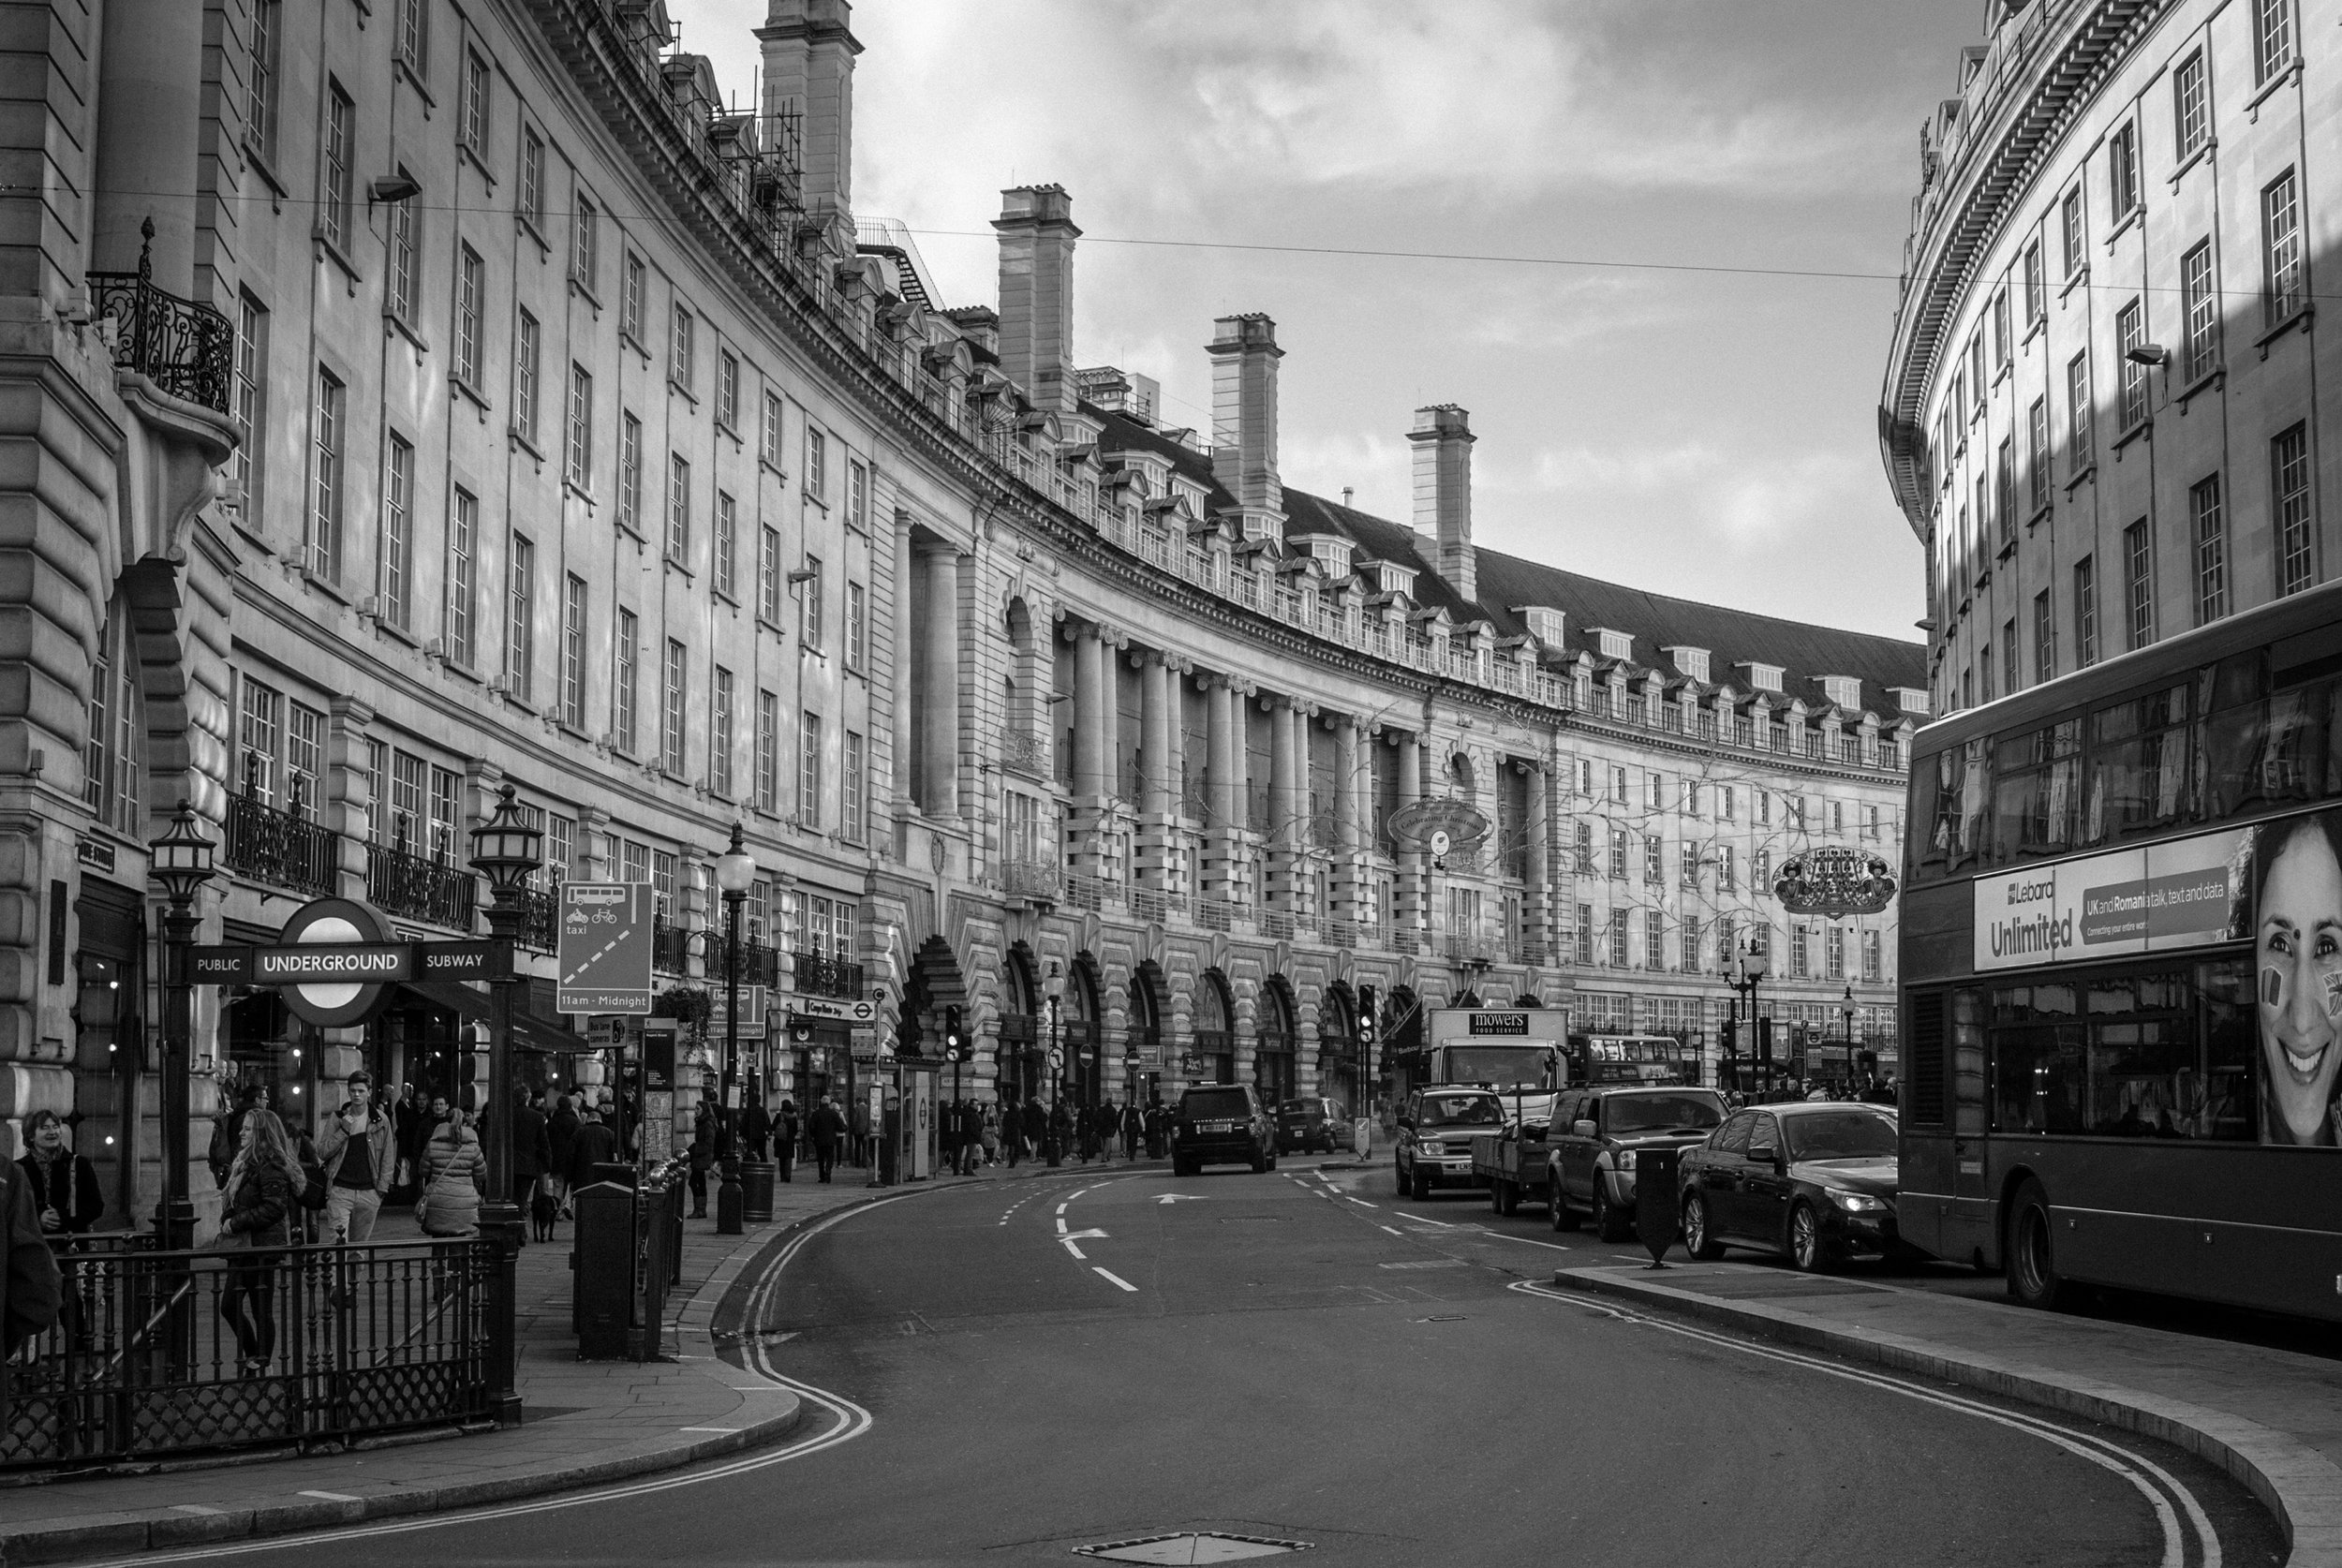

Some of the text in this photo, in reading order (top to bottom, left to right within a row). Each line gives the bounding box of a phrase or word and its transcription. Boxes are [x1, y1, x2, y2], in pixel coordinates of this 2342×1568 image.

[1401, 814, 1481, 831] Celebrating Christmas
[2016, 880, 2053, 904] Lebara
[2086, 881, 2224, 916] UK and Romania talk, text and data
[567, 925, 587, 935] taxi
[1992, 908, 2072, 957] Unlimited
[2086, 925, 2112, 937] Connecting
[2111, 924, 2123, 935] your
[2122, 922, 2136, 932] entire
[198, 954, 483, 971] PUBLIC UNDERGROUND SUBWAY
[561, 996, 589, 1005] 11am
[599, 996, 646, 1008] Midnight
[1475, 1014, 1523, 1026] mowers
[736, 1027, 763, 1035] idnight
[1398, 1045, 1420, 1055] Barbour
